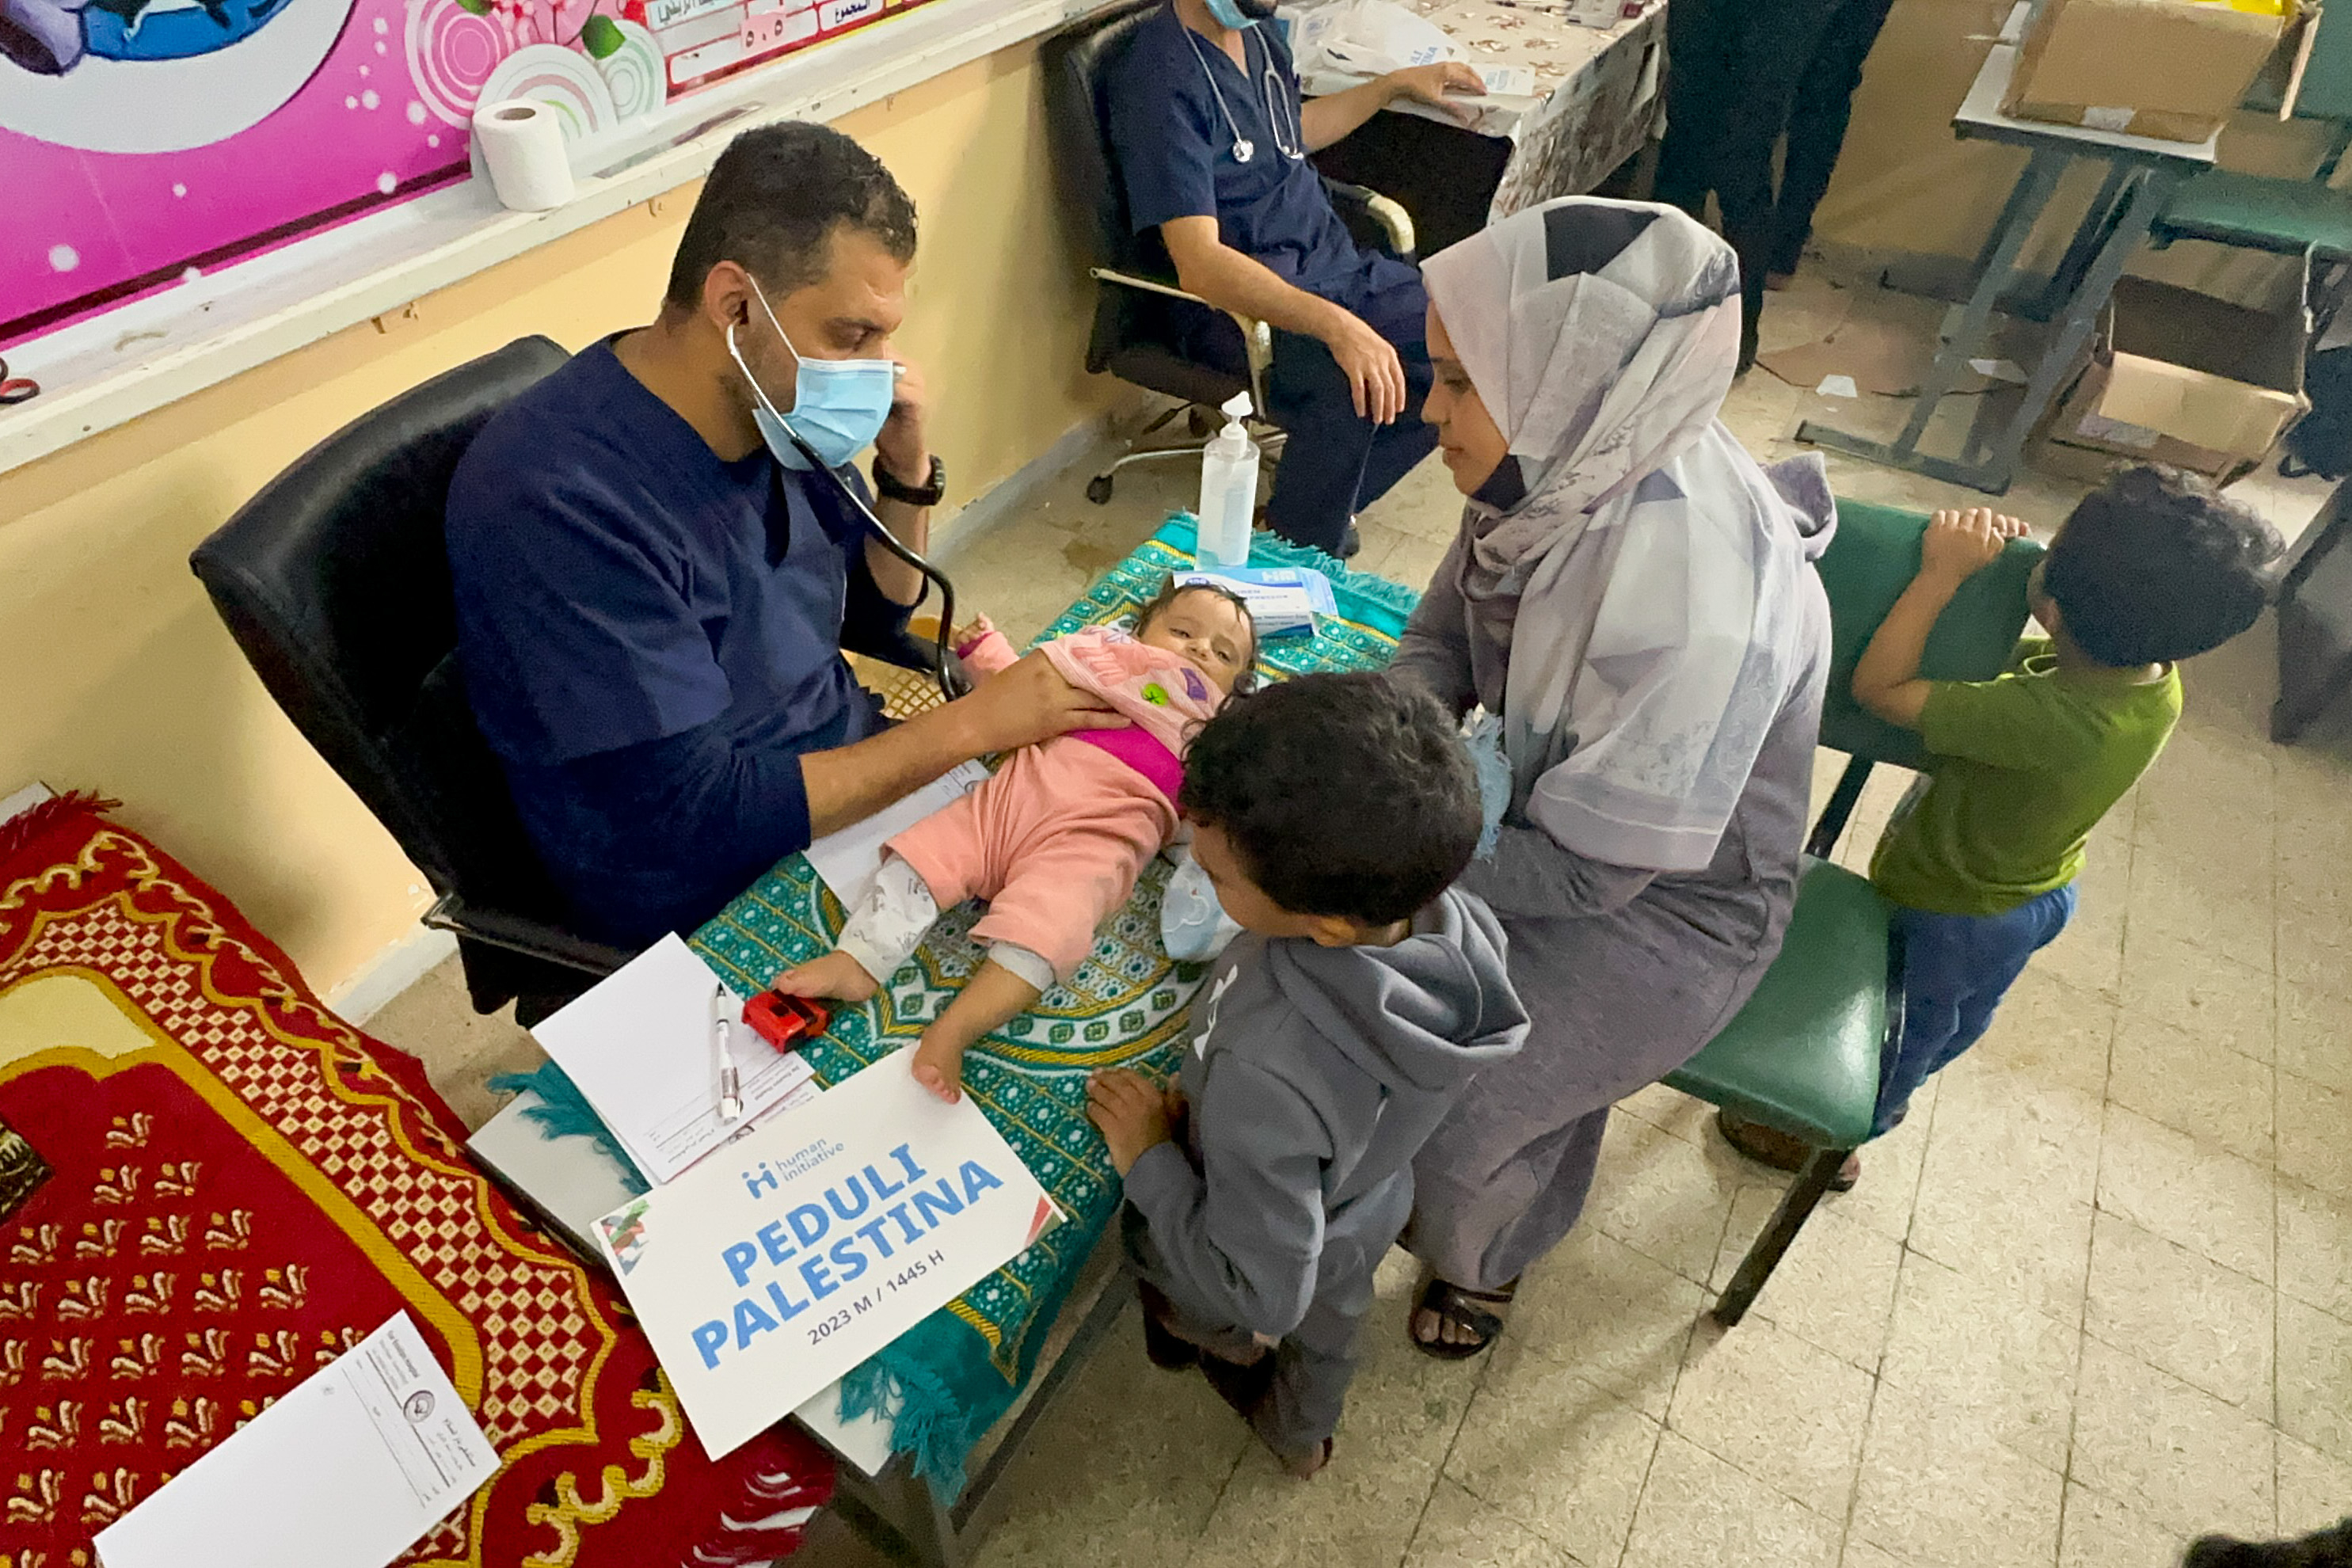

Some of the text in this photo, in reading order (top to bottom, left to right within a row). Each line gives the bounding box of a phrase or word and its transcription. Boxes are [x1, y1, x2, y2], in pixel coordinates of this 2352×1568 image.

[775, 1139, 827, 1172] human
[782, 1142, 845, 1182] initiative
[721, 1143, 927, 1288] PEDULI
[691, 1159, 1004, 1370] PALESTINA
[807, 1249, 946, 1345] 2023 M / 1445 H
